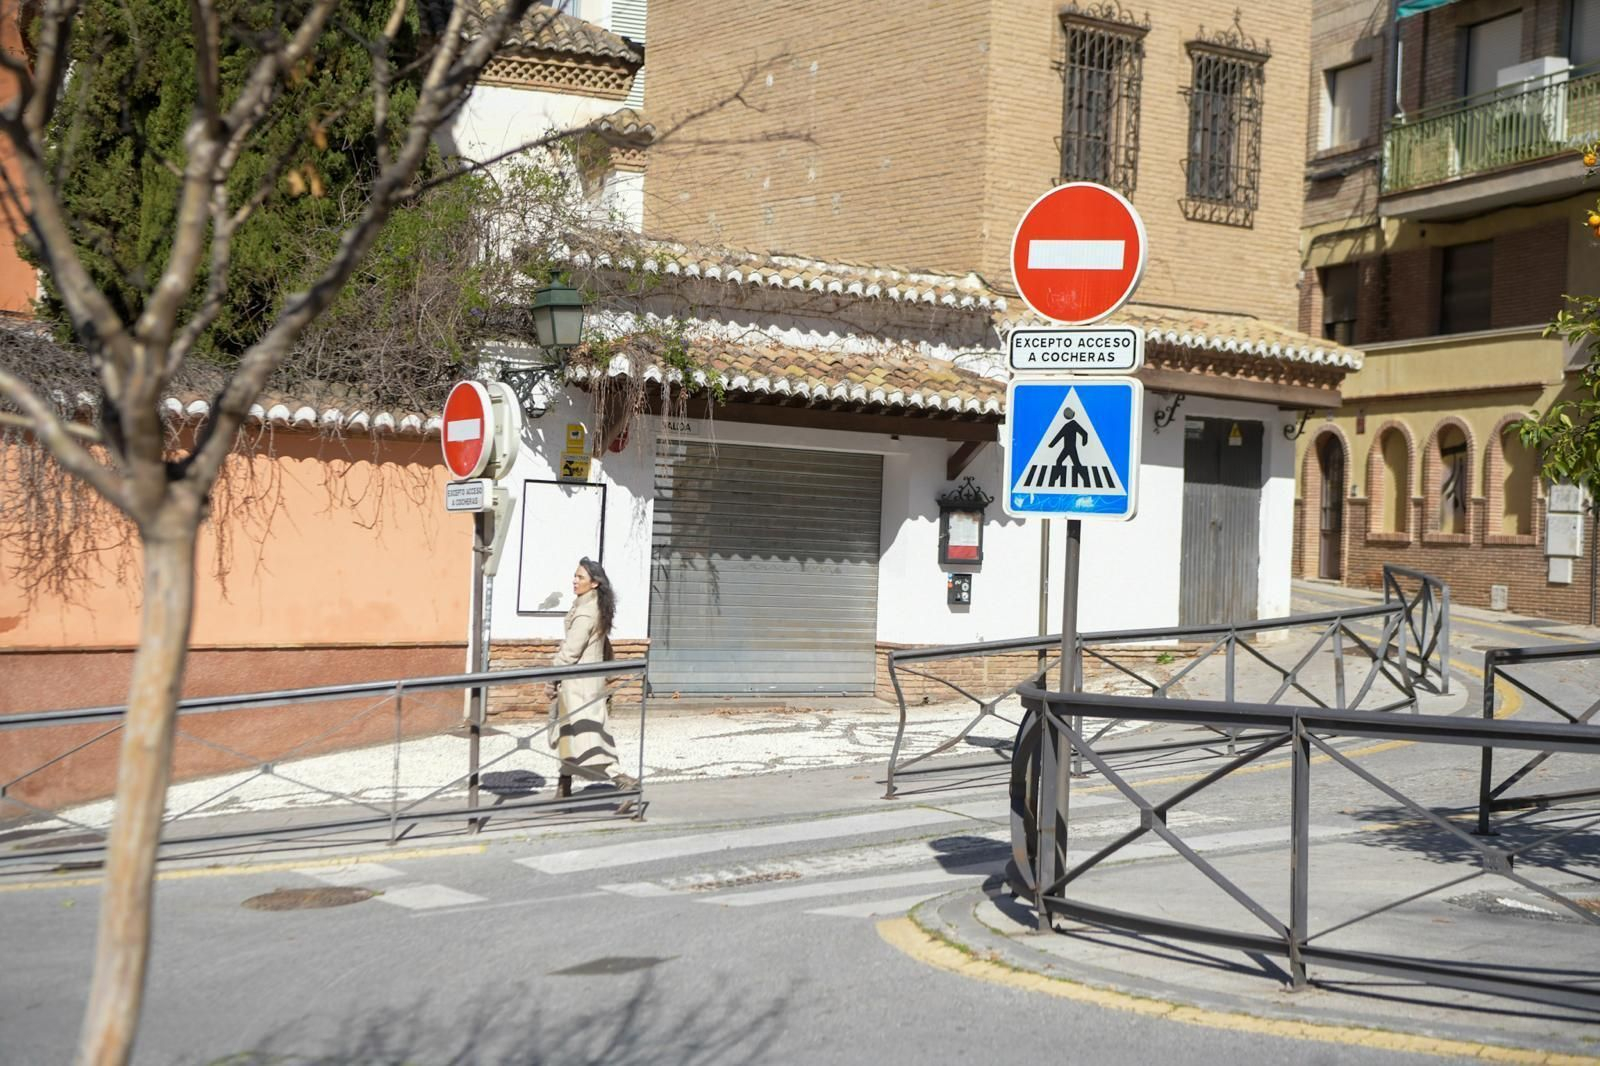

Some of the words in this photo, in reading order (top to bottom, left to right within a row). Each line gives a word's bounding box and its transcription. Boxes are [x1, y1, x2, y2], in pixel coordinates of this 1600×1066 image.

[1015, 338, 1072, 348] EXCEPTO
[1078, 338, 1131, 348] ACCESO
[1028, 352, 1036, 362] A
[1041, 352, 1115, 362] COCHERAS
[663, 421, 691, 432] ALIDA
